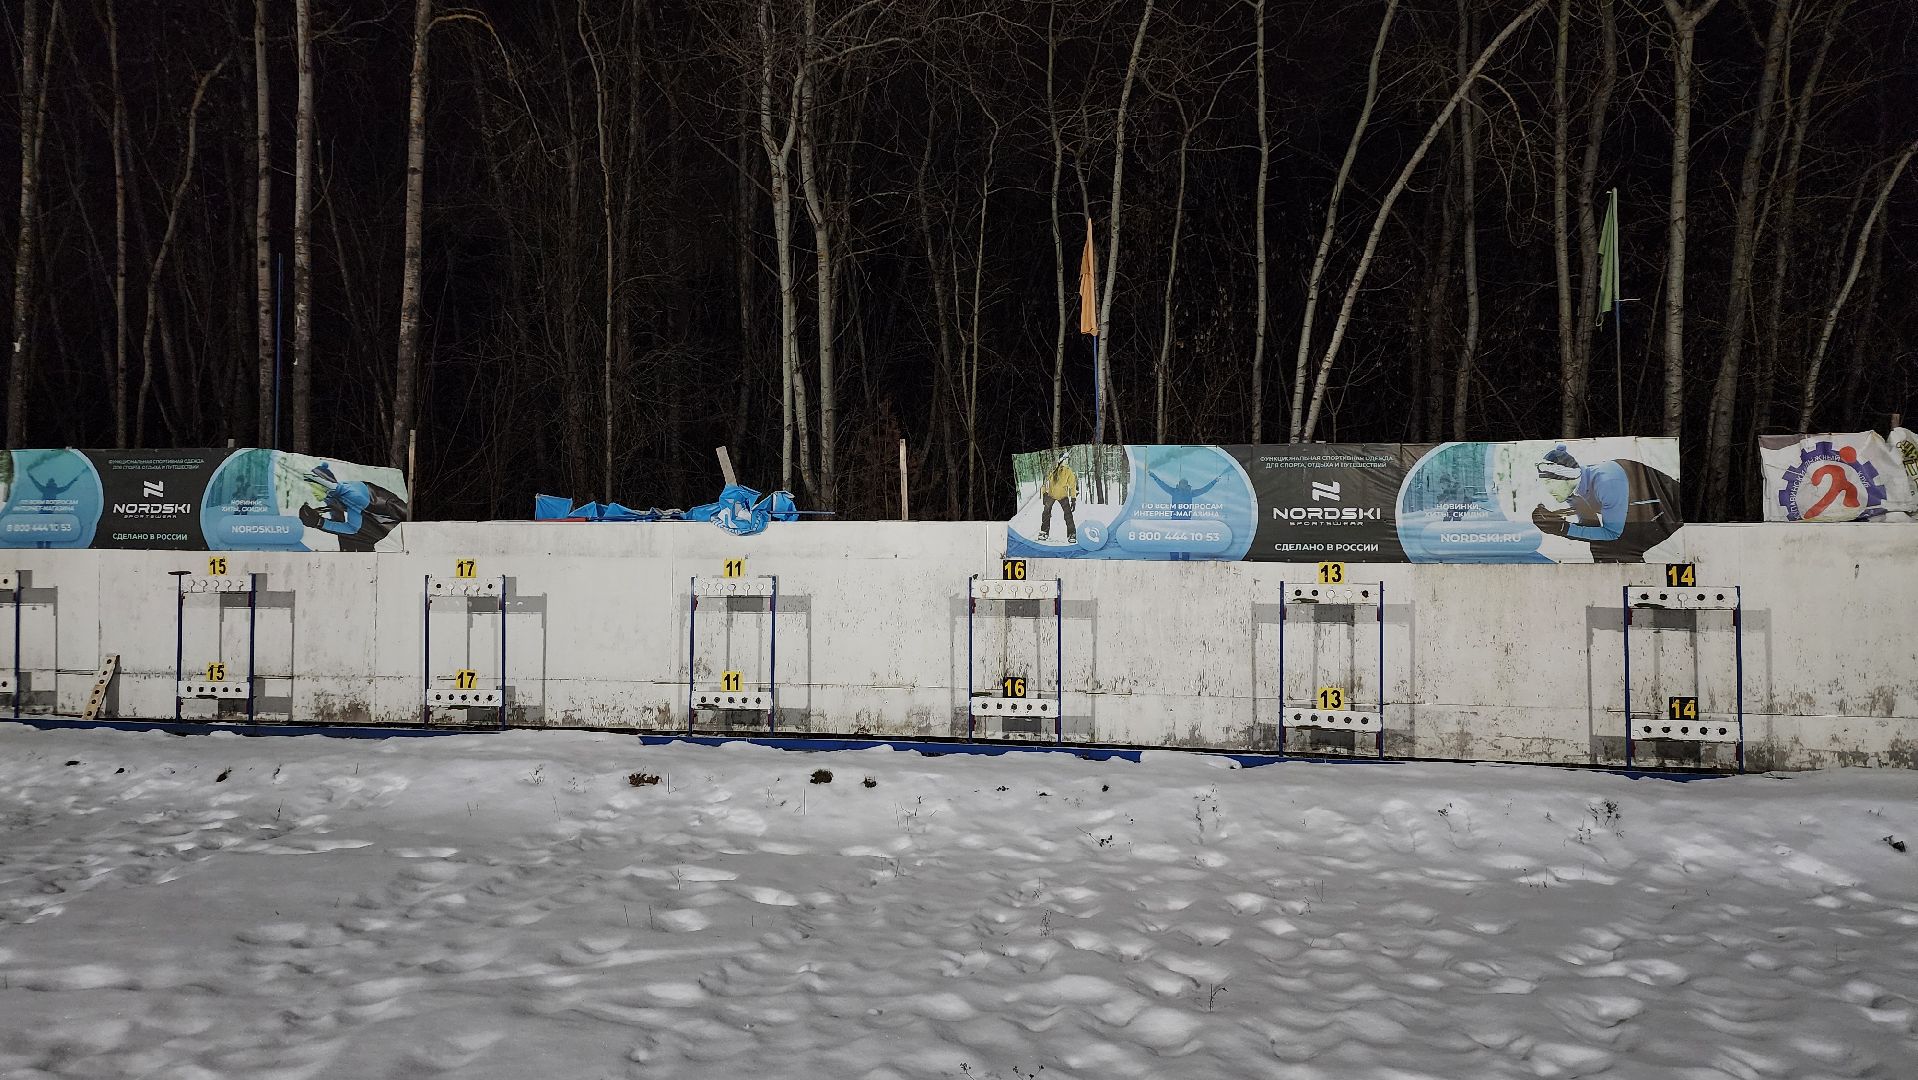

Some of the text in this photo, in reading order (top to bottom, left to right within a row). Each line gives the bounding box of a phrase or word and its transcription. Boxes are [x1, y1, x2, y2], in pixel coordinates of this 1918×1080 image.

[113, 503, 191, 514] NORDSKI
[1272, 507, 1381, 520] NORDSKI
[156, 533, 188, 541] РОССИИ
[231, 525, 289, 533] NORDSKI.RU
[1128, 532, 1220, 542] 8 800 444 10 53
[1440, 533, 1522, 543] NORDSKI.RU
[1274, 543, 1325, 552] СДЕЛАНО
[1335, 544, 1379, 552] РОССИИ
[209, 558, 226, 575] 15
[457, 560, 475, 577] 17
[726, 560, 741, 577] 11
[1004, 561, 1025, 580] 16
[1320, 563, 1342, 582] 13
[1668, 565, 1694, 586] 14
[208, 664, 224, 681] 15
[457, 672, 476, 688] 17
[724, 673, 739, 690] 11
[1004, 679, 1025, 697] 16
[1320, 690, 1342, 708] 13
[1671, 699, 1696, 719] 14
